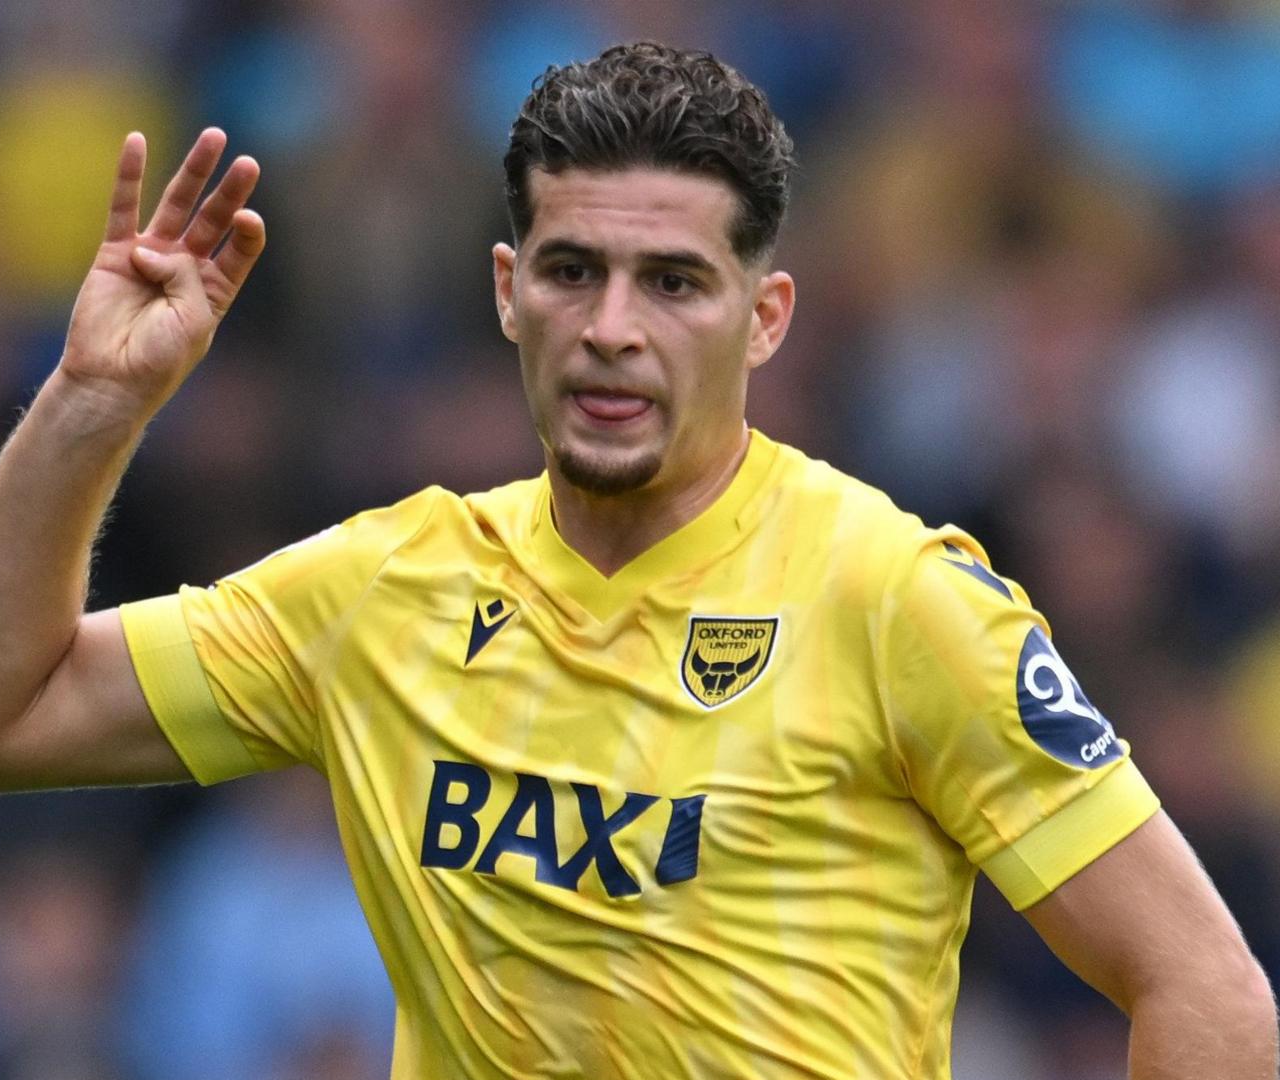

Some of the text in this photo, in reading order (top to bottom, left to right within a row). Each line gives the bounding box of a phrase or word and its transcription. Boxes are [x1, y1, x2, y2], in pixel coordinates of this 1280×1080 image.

[699, 628, 766, 640] OXFORD
[709, 642, 747, 650] UNITED
[420, 760, 707, 898] BAXI
